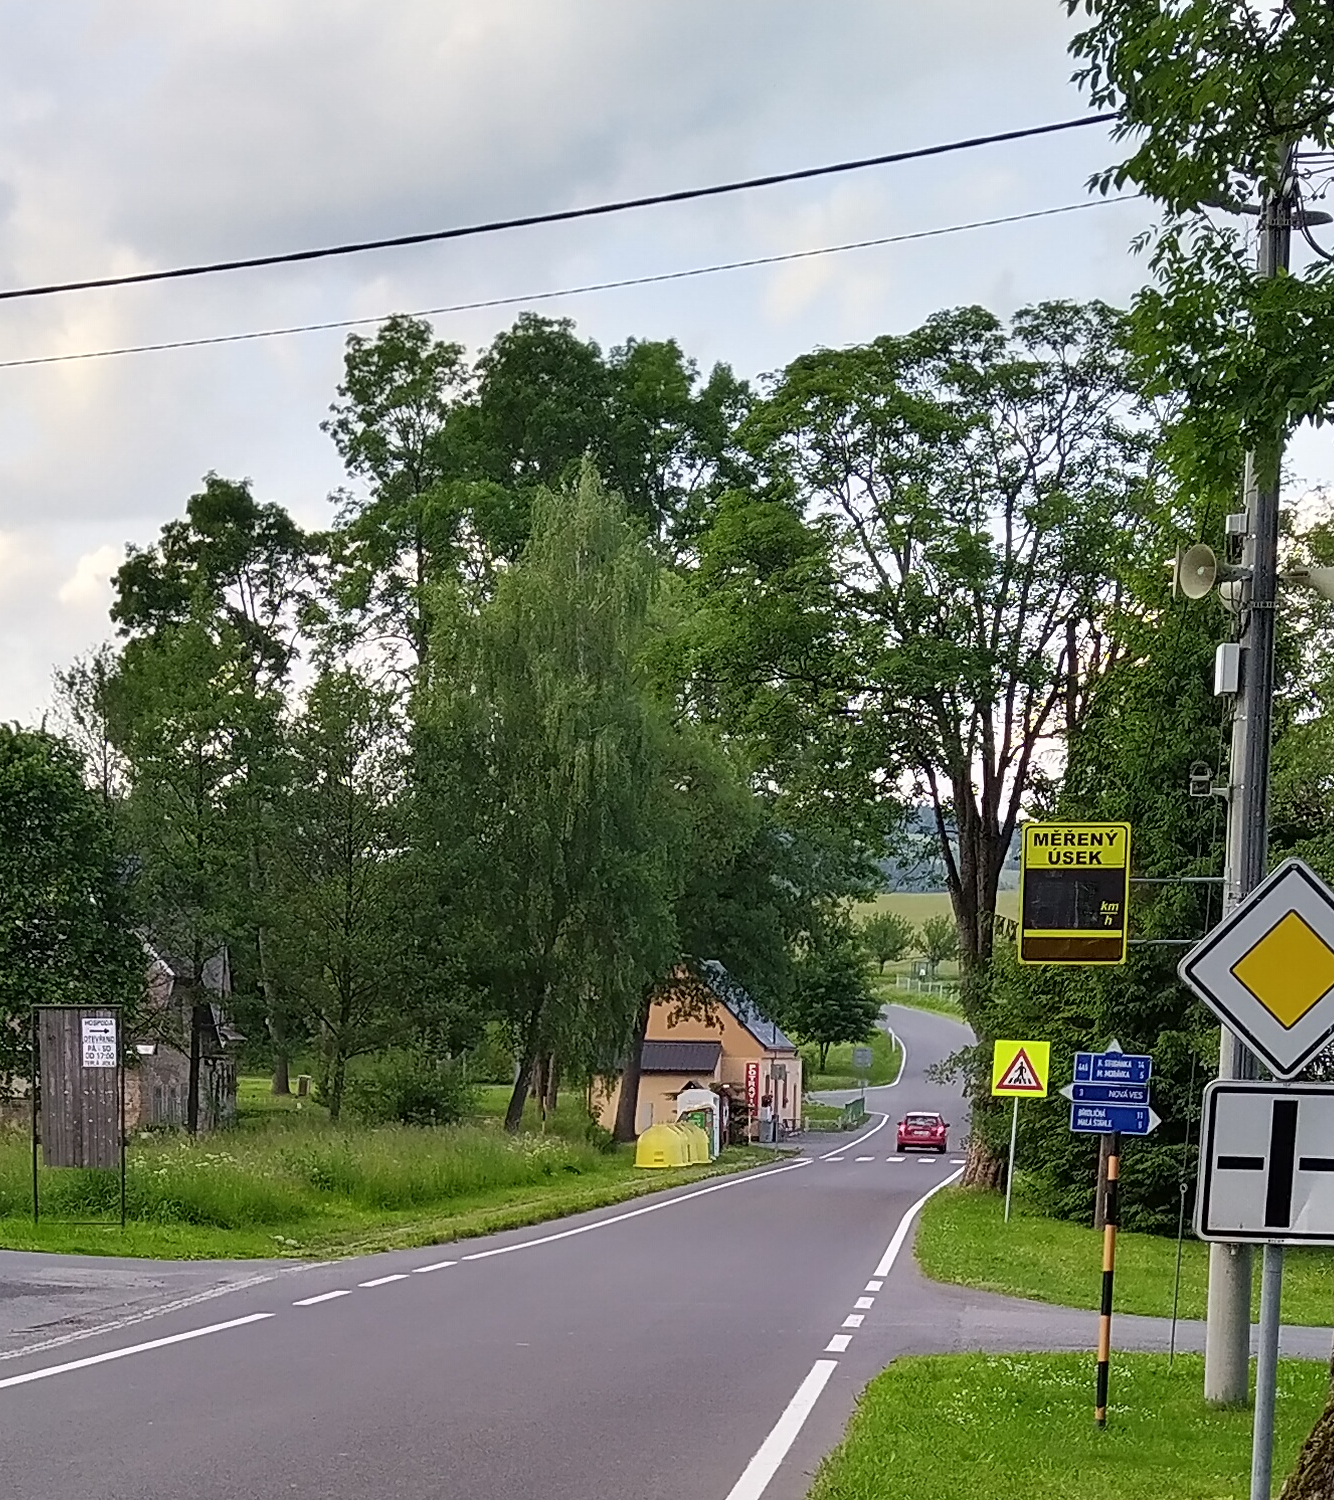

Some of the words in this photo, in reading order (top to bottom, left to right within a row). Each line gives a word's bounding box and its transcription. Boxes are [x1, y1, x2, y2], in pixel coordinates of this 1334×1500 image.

[1033, 829, 1119, 847] MĚŘENÝ
[1048, 847, 1102, 865] ÚSEK
[1100, 900, 1119, 911] km
[1104, 915, 1113, 926] h
